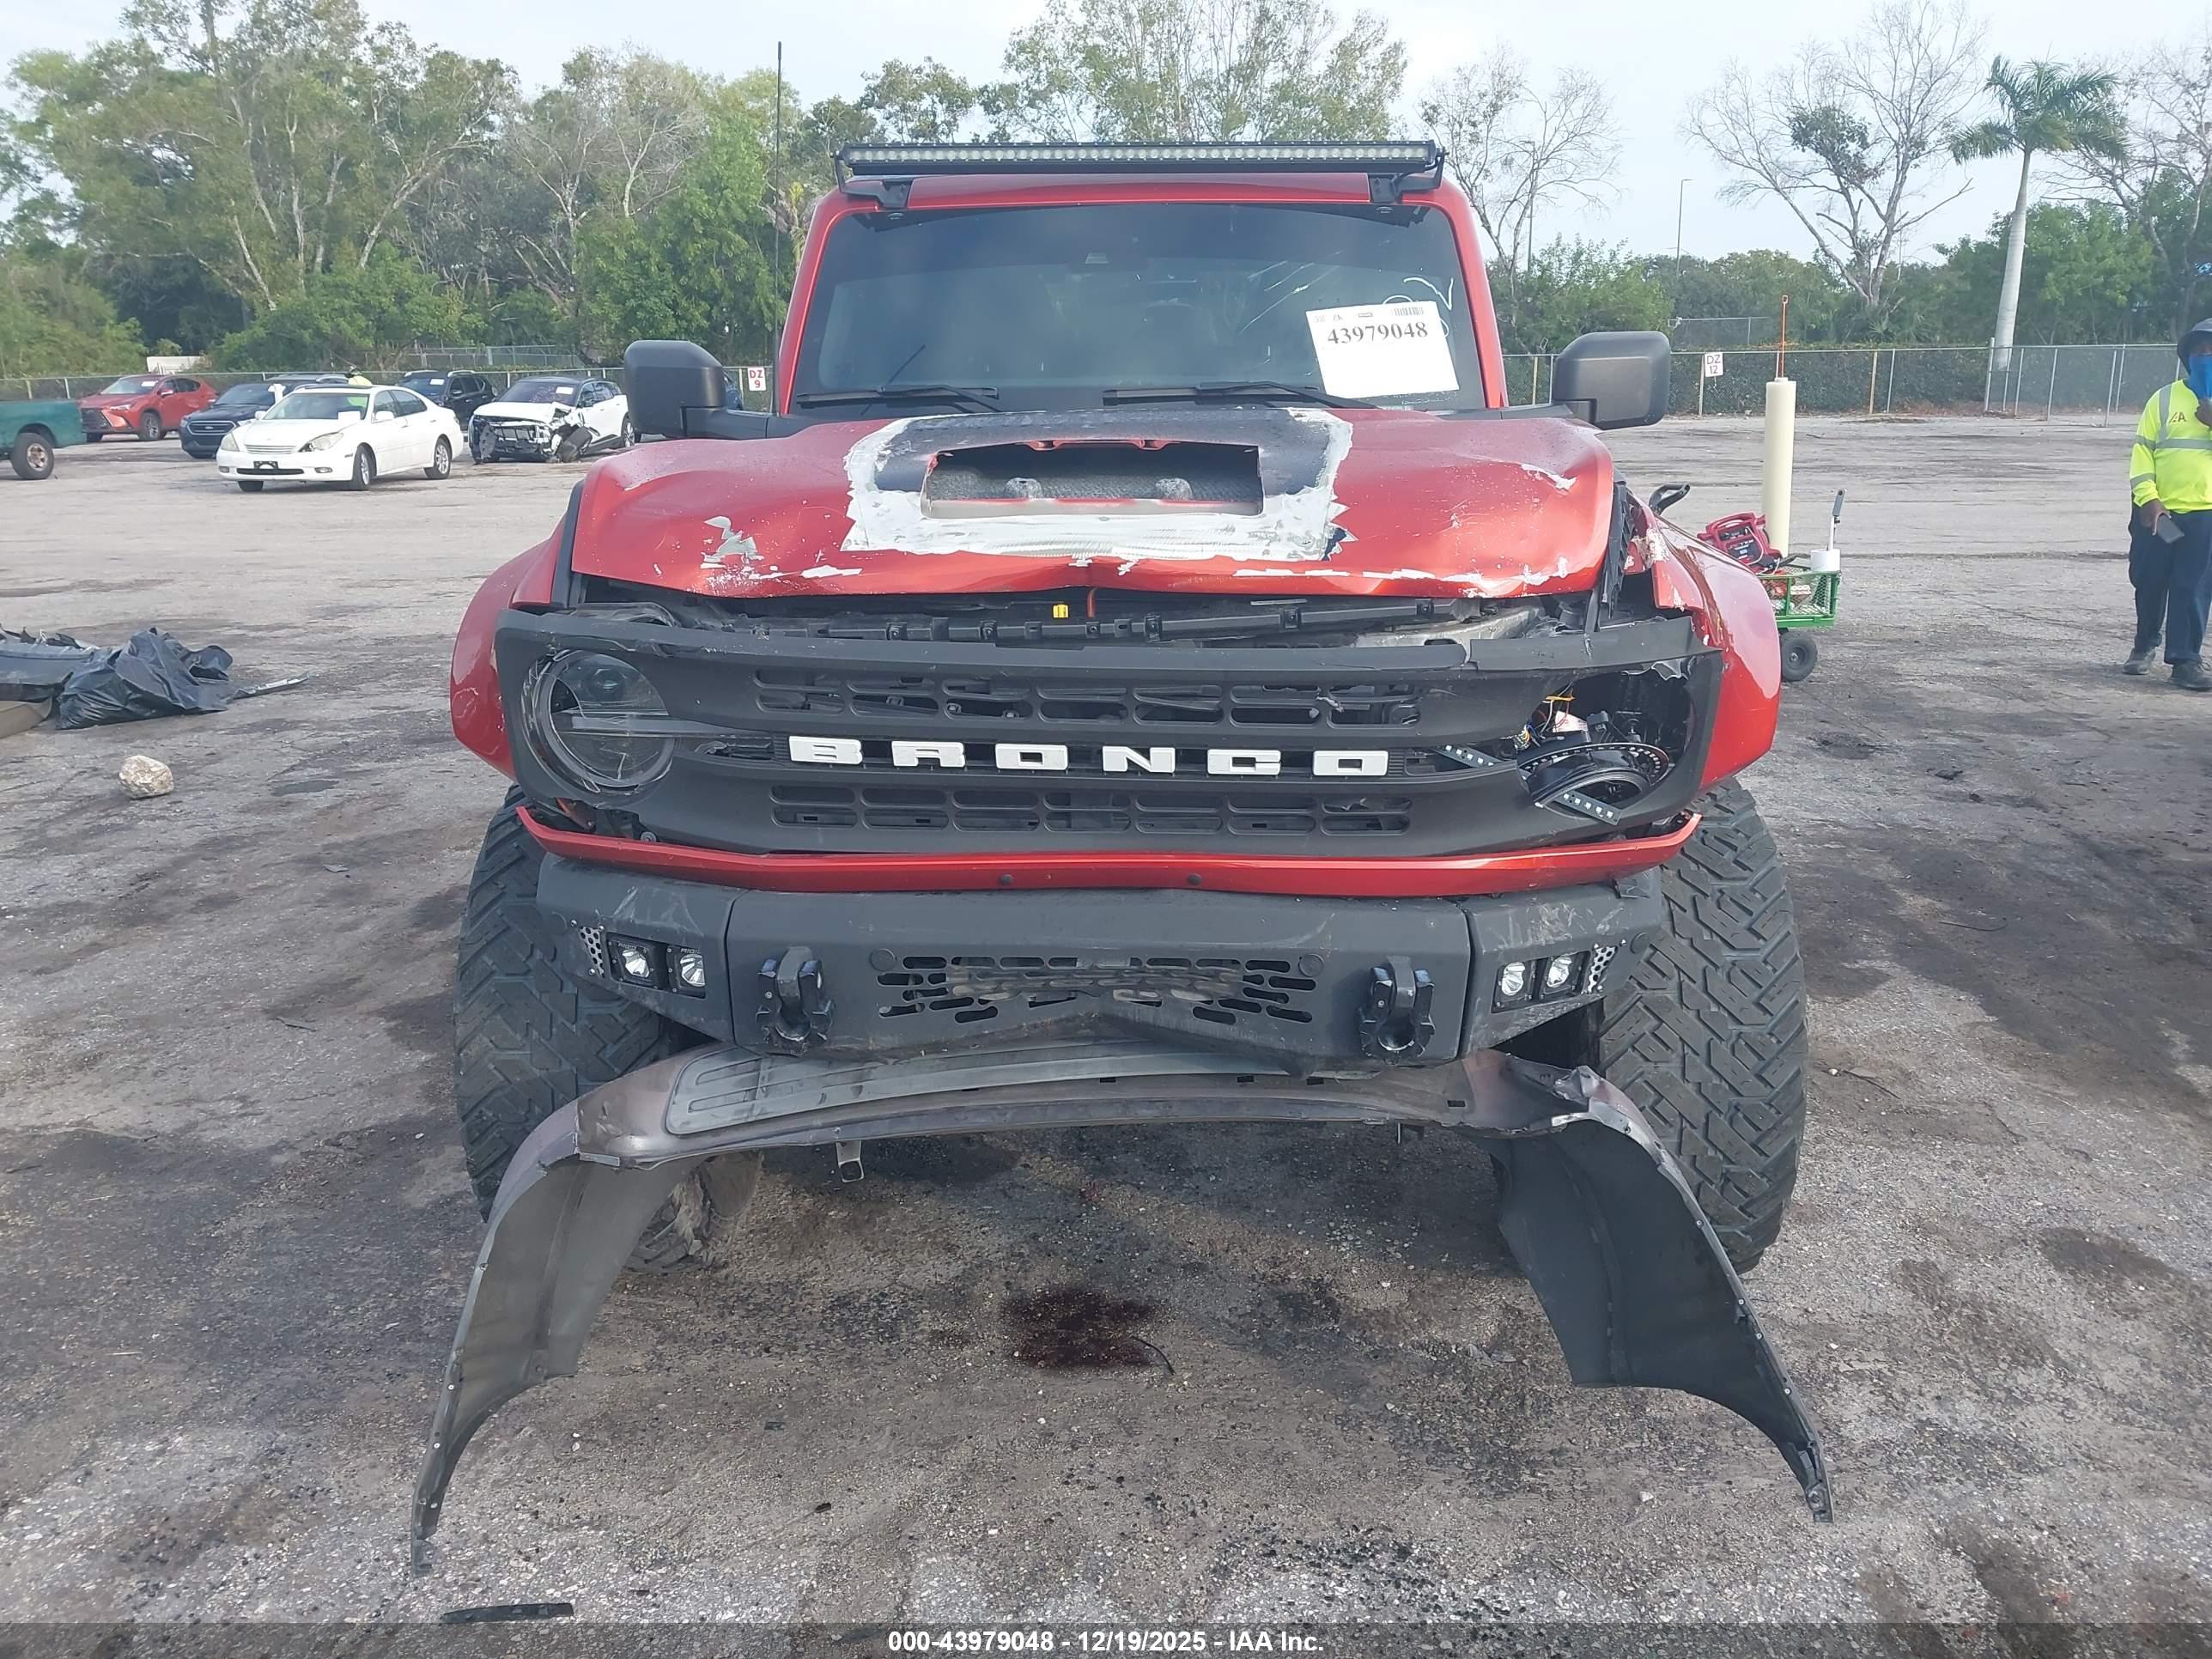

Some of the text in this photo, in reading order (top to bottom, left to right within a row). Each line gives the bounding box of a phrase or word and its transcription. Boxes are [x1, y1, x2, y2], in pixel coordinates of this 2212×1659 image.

[1327, 321, 1428, 344] 43979048
[1706, 354, 1721, 364] DZ
[749, 369, 763, 379] DZ
[1710, 365, 1718, 374] 12
[754, 380, 761, 388] 9
[788, 735, 1389, 776] BRONCO
